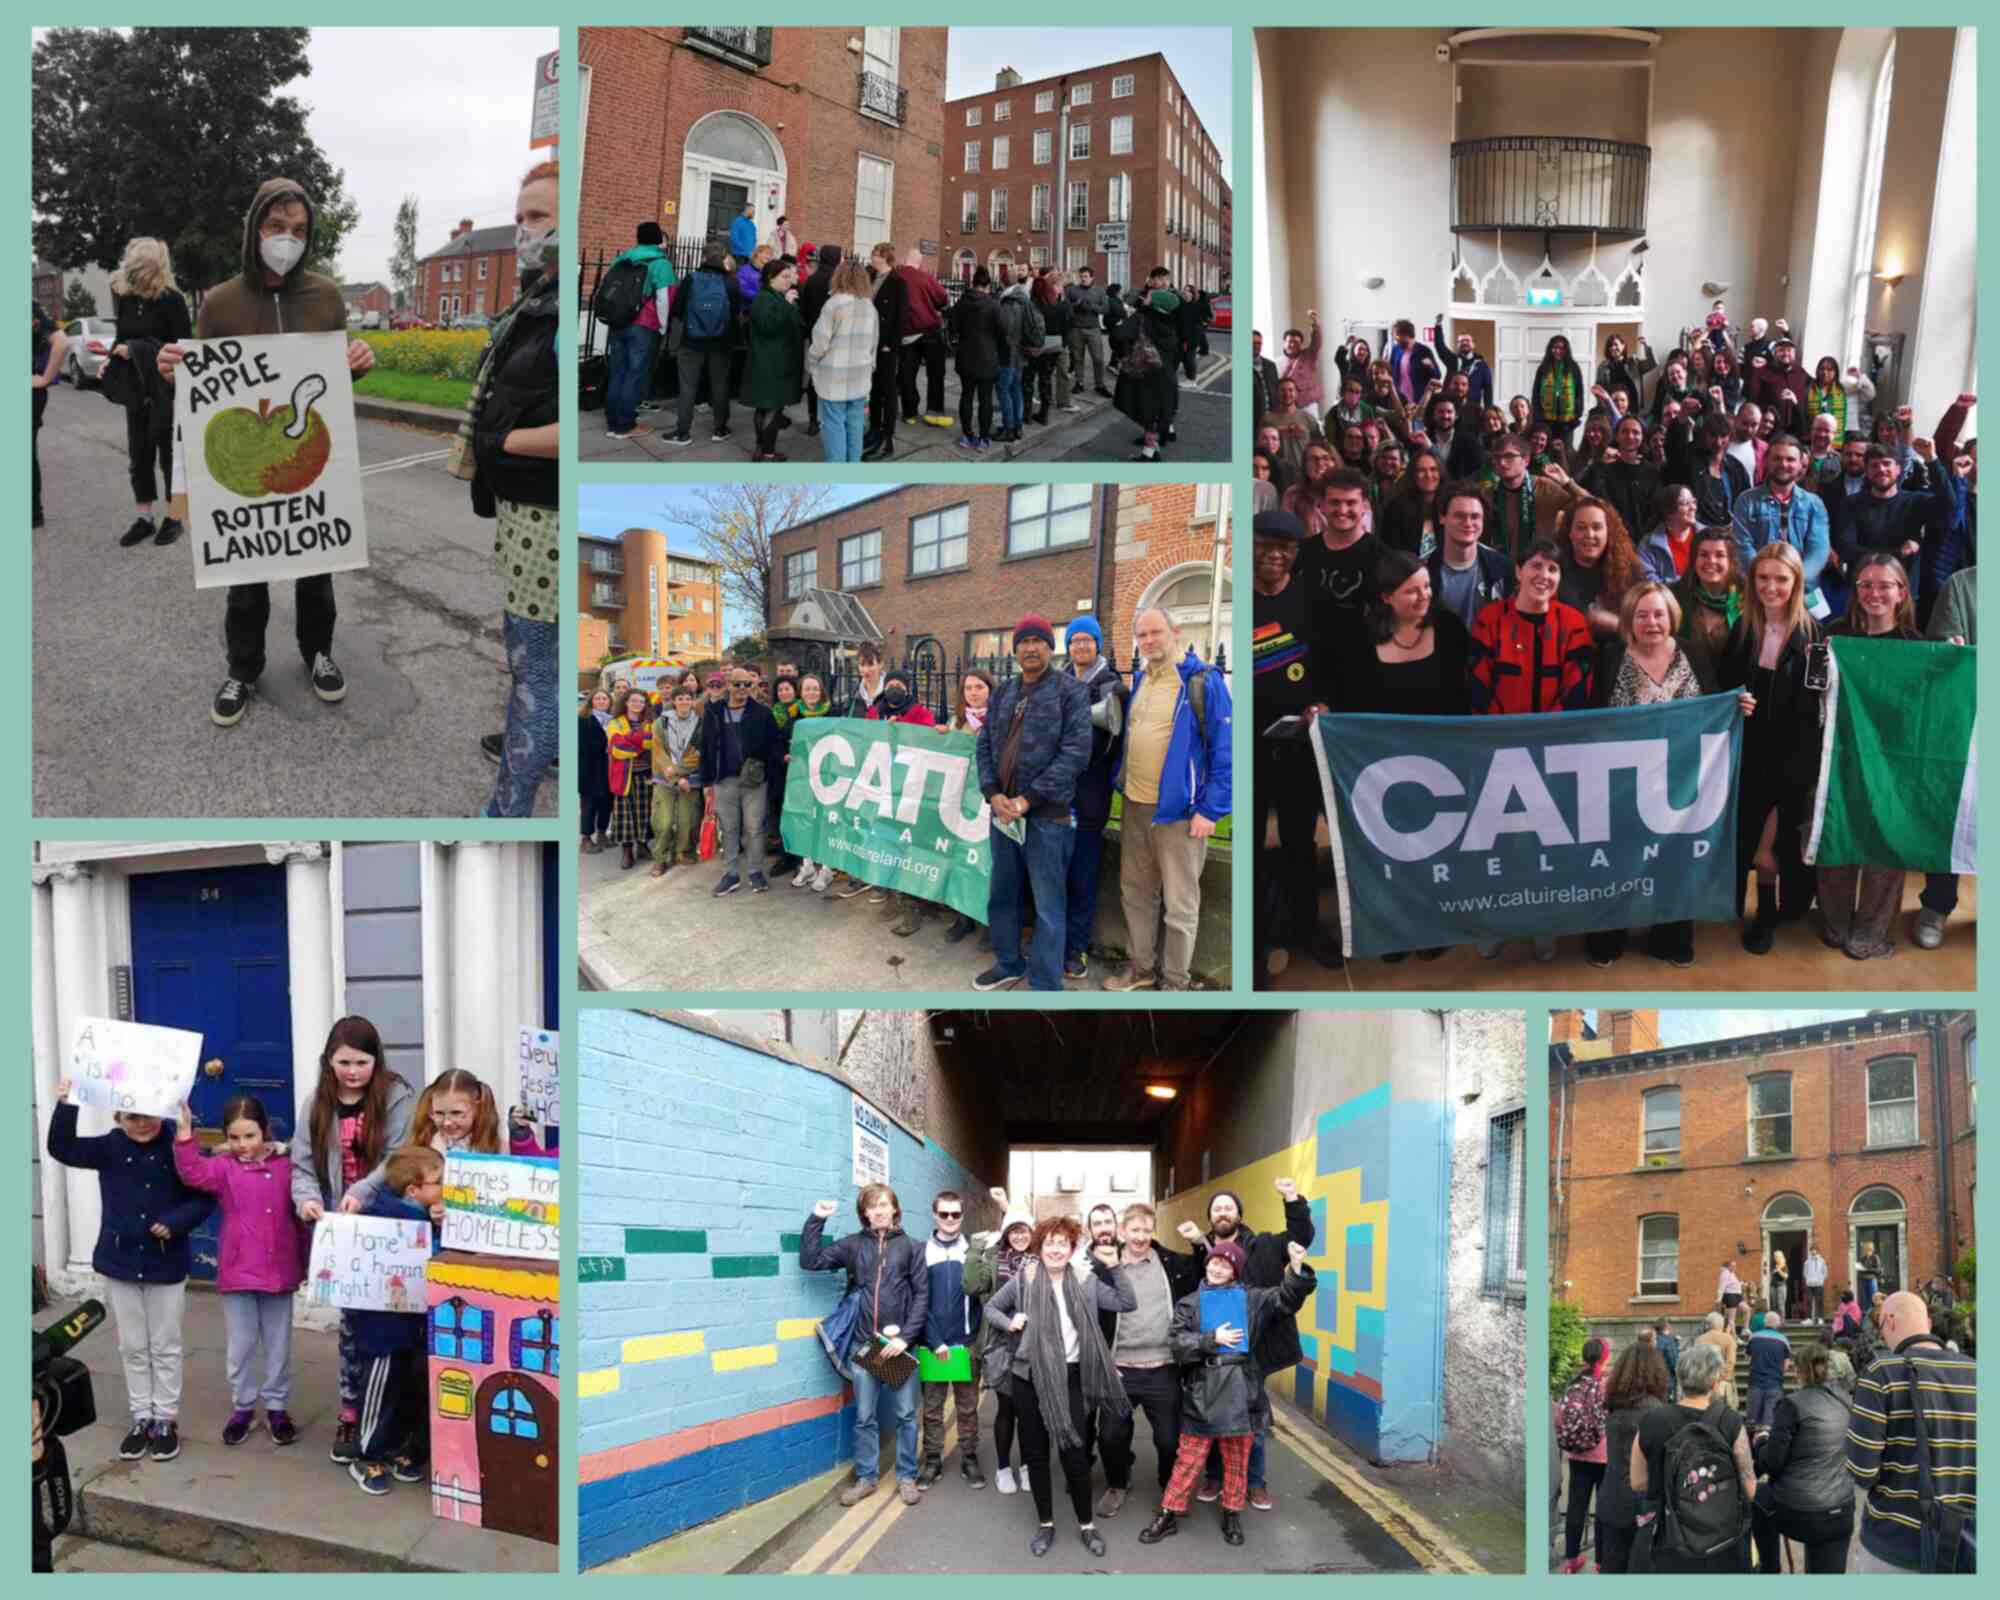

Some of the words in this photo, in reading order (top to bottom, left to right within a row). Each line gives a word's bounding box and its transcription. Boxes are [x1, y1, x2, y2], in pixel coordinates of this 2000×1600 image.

[183, 340, 242, 377] BAD
[190, 352, 280, 413] APPLE
[212, 491, 325, 536] ROTTEN
[203, 517, 352, 566] LANDLORD
[808, 735, 991, 843] CATU
[1351, 731, 1730, 862] CATU
[1384, 840, 1711, 883] IRELAND
[1439, 875, 1655, 913] www.catuireland.org
[77, 1025, 95, 1050] A
[449, 1160, 510, 1192] Homes
[319, 1221, 336, 1249] A
[353, 1221, 400, 1254] home
[447, 1214, 559, 1252] HOMELESS
[351, 1257, 361, 1273] a
[372, 1254, 422, 1278] human
